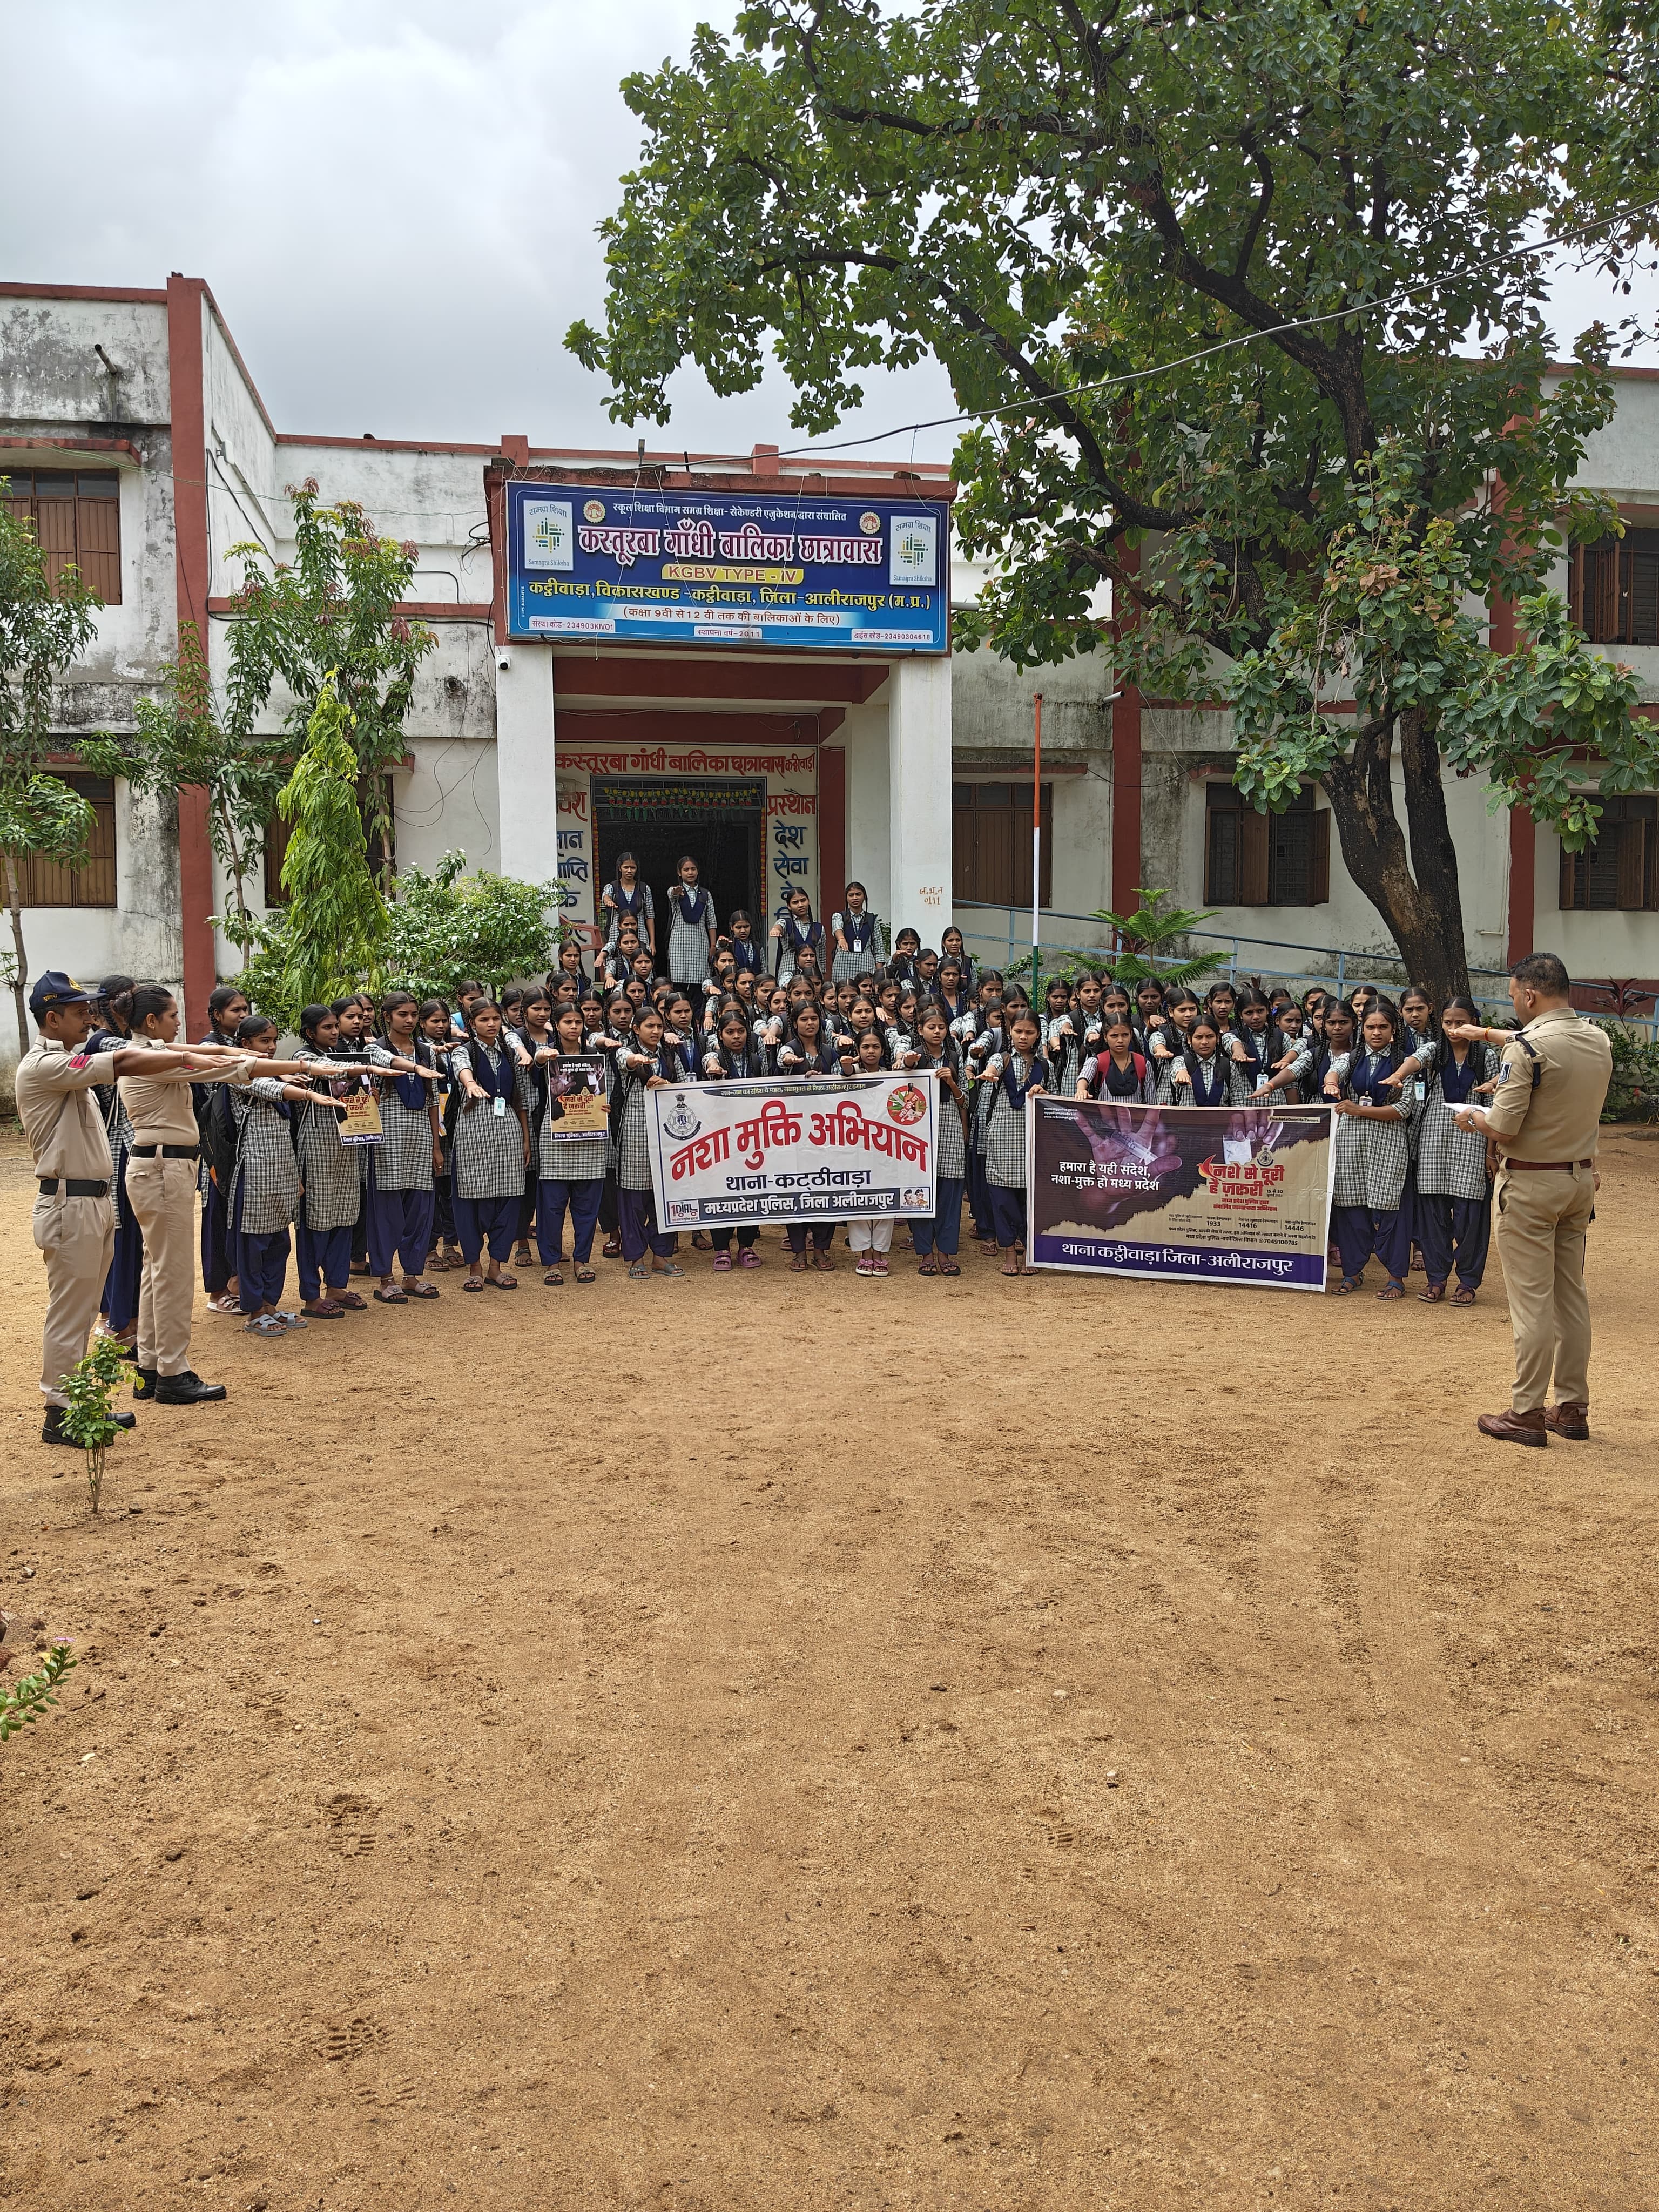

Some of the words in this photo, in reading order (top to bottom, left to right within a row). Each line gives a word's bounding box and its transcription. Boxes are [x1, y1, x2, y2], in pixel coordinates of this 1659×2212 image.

[529, 504, 548, 516] समग्र
[550, 504, 567, 518] शिक्षा
[613, 503, 633, 514] स्कूल
[634, 501, 655, 513] शिक्षा
[682, 506, 702, 515] समग्र
[764, 507, 796, 521] एजुकेशन
[798, 511, 815, 520] द्वारा
[816, 509, 847, 521] संचालित
[895, 521, 913, 532] समग्र
[914, 520, 931, 533] शिक्षा
[578, 526, 660, 566] कस्तूरबा
[664, 518, 716, 558] गाँधी
[719, 523, 794, 561] बालिका
[798, 535, 883, 564] छात्रावास
[669, 566, 718, 579] KGBV
[722, 568, 765, 581] TYPE
[781, 570, 797, 583] IV
[532, 619, 548, 628] संस्था
[717, 612, 735, 621] तक
[738, 611, 751, 621] की
[753, 611, 801, 623] बालिकाओं
[805, 613, 814, 623] के
[555, 753, 629, 774] कस्तूरबा
[630, 747, 667, 771] गांधी
[668, 750, 730, 772] बालिका
[730, 756, 786, 779] छात्रावास
[767, 794, 817, 816] प्रस्थान
[773, 820, 807, 849] देश
[773, 850, 809, 879] सेवा
[670, 1126, 730, 1180] नशा
[735, 1100, 803, 1170] मुक्ति
[808, 1101, 928, 1172] अभियान
[1059, 1162, 1087, 1172] हमारा
[1089, 1159, 1096, 1174] है
[1098, 1162, 1117, 1176] यही
[1213, 1163, 1242, 1179] नशे
[1244, 1163, 1258, 1180] से
[1260, 1164, 1285, 1186] दूरी
[1051, 1174, 1095, 1189] नशा-मुक्त
[1097, 1175, 1108, 1188] हो
[1110, 1179, 1132, 1189] मध्य
[1134, 1177, 1160, 1191] प्रदेश
[1209, 1178, 1219, 1195] है
[704, 1197, 758, 1214] मध्यप्रदेश
[799, 1193, 830, 1209] जिला
[832, 1191, 894, 1210] अलीराजपुर
[1062, 1244, 1096, 1257] थाना
